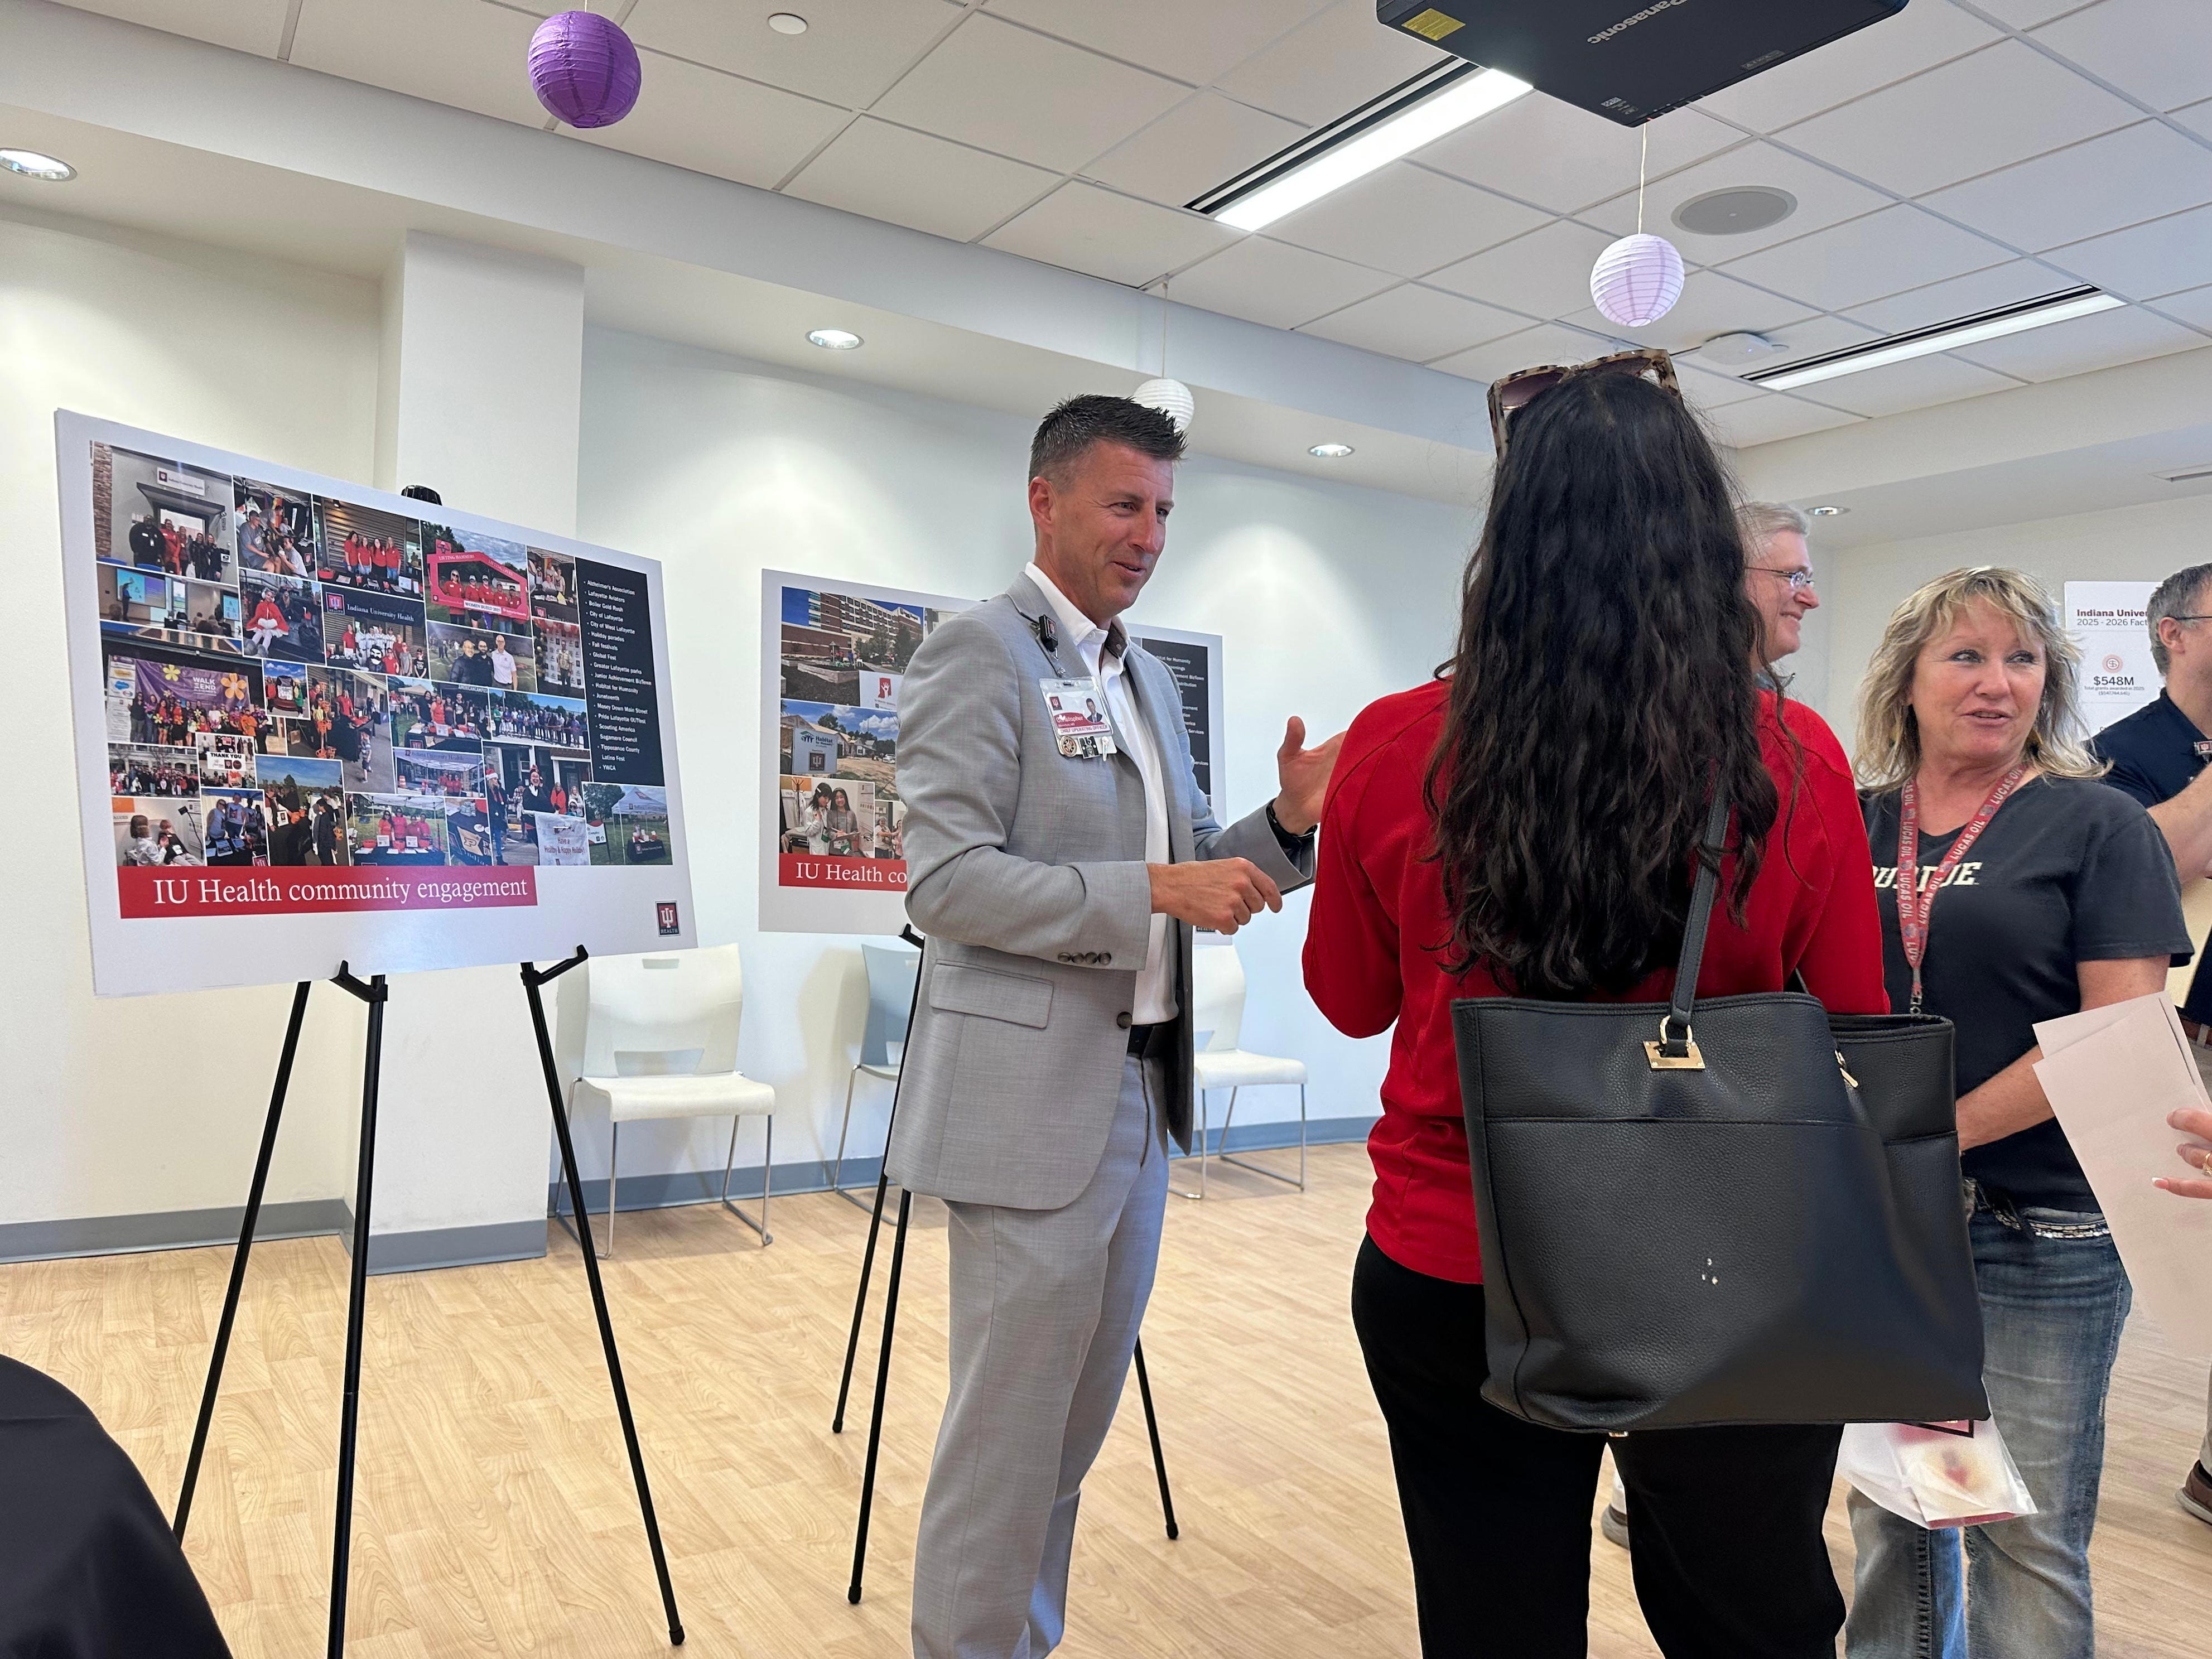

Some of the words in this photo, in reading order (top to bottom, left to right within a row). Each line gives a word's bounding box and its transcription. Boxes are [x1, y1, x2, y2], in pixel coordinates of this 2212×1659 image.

[346, 604, 368, 613] Indiana
[370, 607, 396, 620] University
[193, 677, 215, 685] WALK
[2094, 676, 2134, 686] $548M
[1989, 778, 2014, 804] LUCAS
[1902, 821, 1914, 845] LUCAS
[1949, 833, 1974, 860] LUCAS
[1969, 820, 1986, 833] OIL
[1901, 846, 1912, 858] OIL
[796, 862, 820, 879] IU
[826, 864, 883, 882] Health
[154, 880, 189, 904] IU
[197, 879, 282, 903] Health
[288, 877, 411, 904] community
[417, 878, 528, 903] engagement
[1900, 873, 1912, 901] LUCAS
[1929, 876, 1943, 890] OIL
[1901, 903, 1913, 919] OIL
